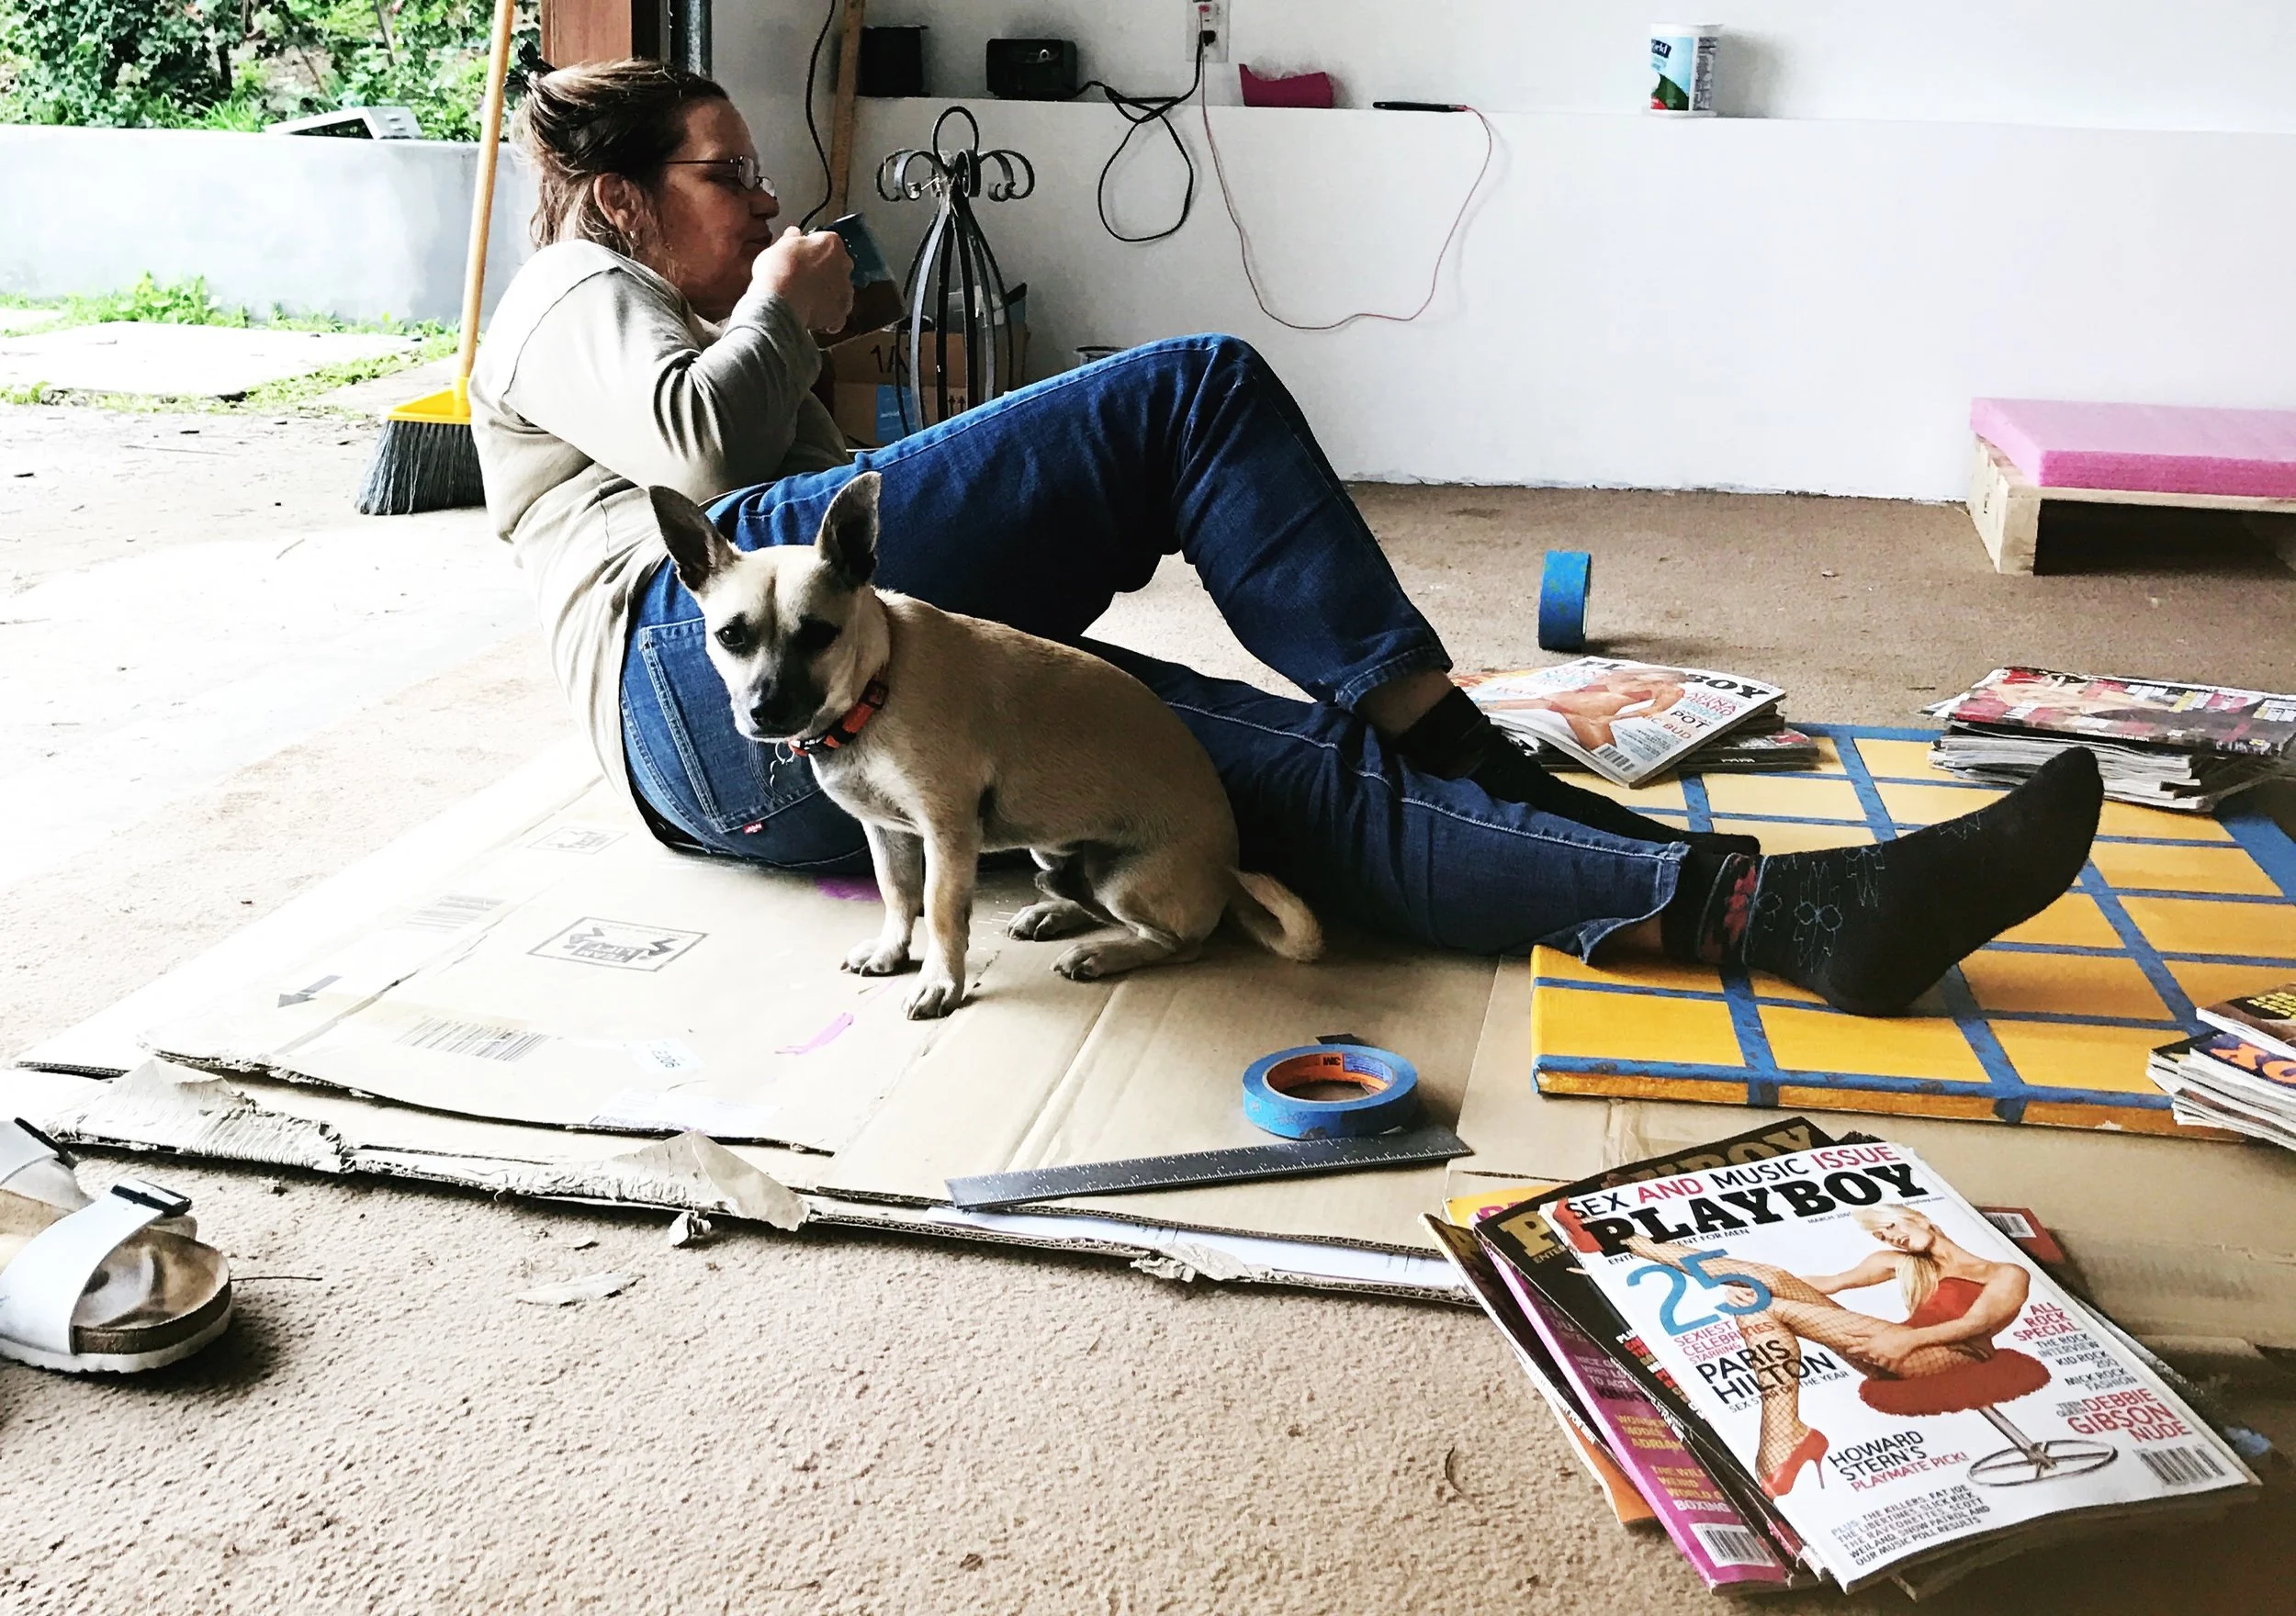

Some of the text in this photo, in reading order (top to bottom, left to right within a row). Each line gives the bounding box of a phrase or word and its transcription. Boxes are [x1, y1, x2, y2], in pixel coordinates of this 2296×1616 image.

[1578, 659, 1771, 699] PLBOY
[1662, 723, 1693, 740] BUD
[1671, 710, 1709, 728] POT
[1322, 1056, 1341, 1066] 3M
[1566, 1146, 1902, 1221] SEX AND MUSIC ISSUE
[1578, 1162, 1930, 1258] PLAYBOY
[1701, 1232, 1723, 1242] FOR
[1725, 1228, 1750, 1239] MEN
[1626, 1248, 1773, 1338] 25
[2023, 1310, 2073, 1328] ROCK
[2029, 1302, 2062, 1316] ALL
[1673, 1320, 1734, 1348] SEXIEST
[1682, 1321, 1776, 1356] CELEBRITIES
[2012, 1321, 2082, 1342] SPECIAL
[2036, 1332, 2092, 1349] THE ROCK
[1688, 1342, 1743, 1365] STARRING
[1695, 1339, 1791, 1385] PARIS
[2037, 1341, 2100, 1358] INTERVIEW
[2055, 1350, 2110, 1366] KID ROCK
[1587, 1375, 1604, 1386] TO
[1711, 1352, 1838, 1405] HILTON
[2064, 1367, 2129, 1386] MICK ROCK
[2084, 1375, 2138, 1392] FASHION
[1728, 1400, 1749, 1414] SEX
[1750, 1387, 1779, 1408] STAR
[1798, 1376, 1819, 1389] THE
[1820, 1369, 1850, 1385] YEAR
[2081, 1387, 2159, 1413] DEBBIE
[2066, 1402, 2178, 1435] GIBSON
[2128, 1421, 2193, 1443] NUDE
[1827, 1431, 1924, 1469] HOWARD
[1840, 1445, 1928, 1482] STERN'S
[1850, 1451, 1970, 1493] PLAYMATE PICK!
[1672, 1499, 1733, 1513] BOXING
[1862, 1509, 1882, 1521] THE
[1929, 1488, 1948, 1500] FAT
[1838, 1530, 1858, 1543] THE
[1919, 1498, 1951, 1511] SLICK
[1843, 1535, 1865, 1551] THE
[1949, 1497, 1984, 1511] SCOTT
[1897, 1521, 1929, 1537] SNOW
[1929, 1510, 1968, 1526] PATROL
[1969, 1505, 1990, 1516] AND
[1855, 1516, 1981, 1566] OUR MUSIC POLL RESULTS
